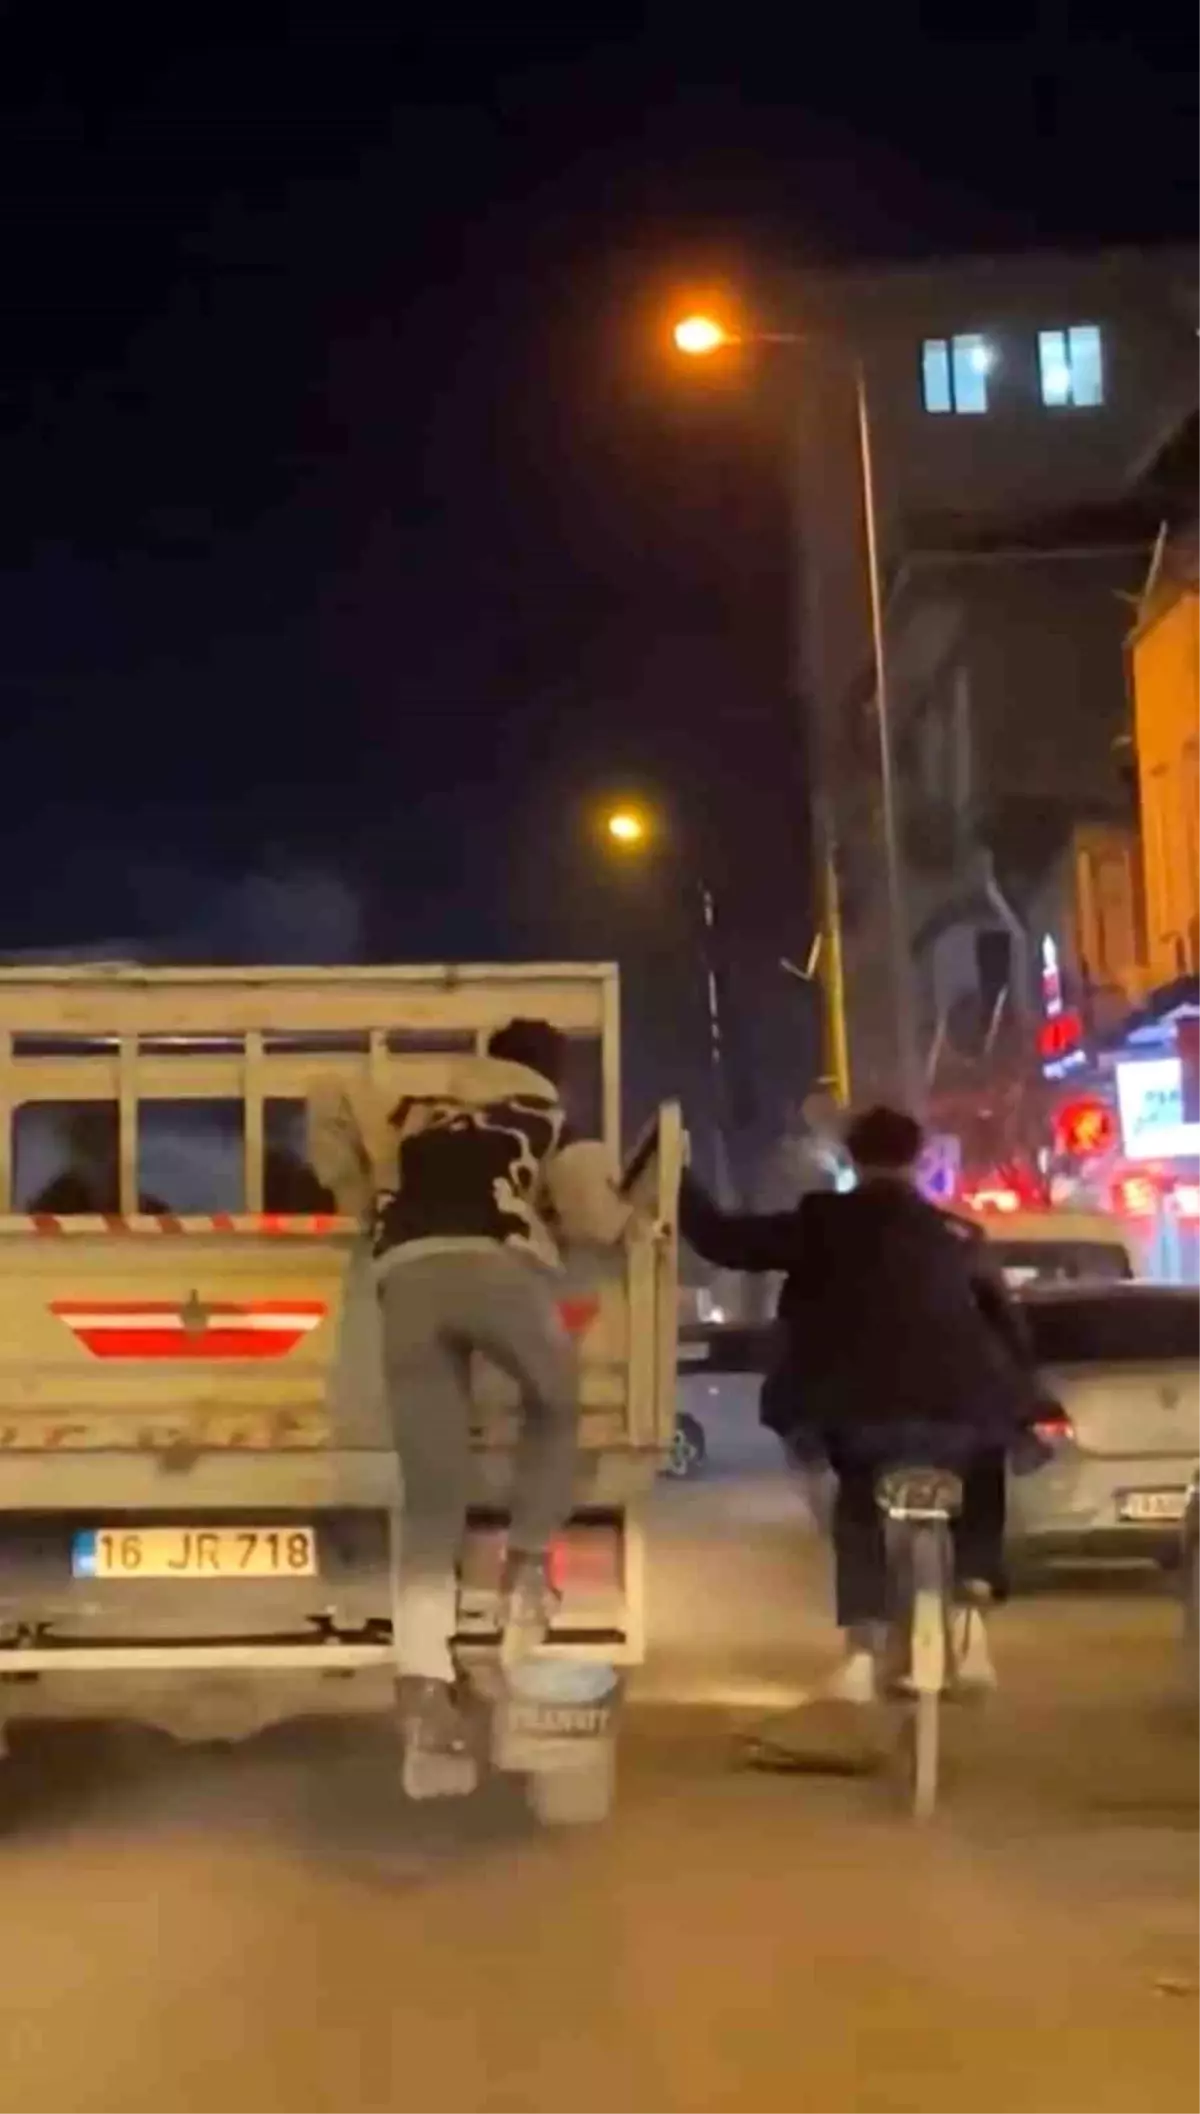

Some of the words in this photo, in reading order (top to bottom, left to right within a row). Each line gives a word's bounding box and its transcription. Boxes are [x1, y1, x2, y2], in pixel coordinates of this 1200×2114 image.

[100, 1533, 142, 1570] 16
[168, 1532, 220, 1570] JR
[235, 1532, 309, 1569] 718
